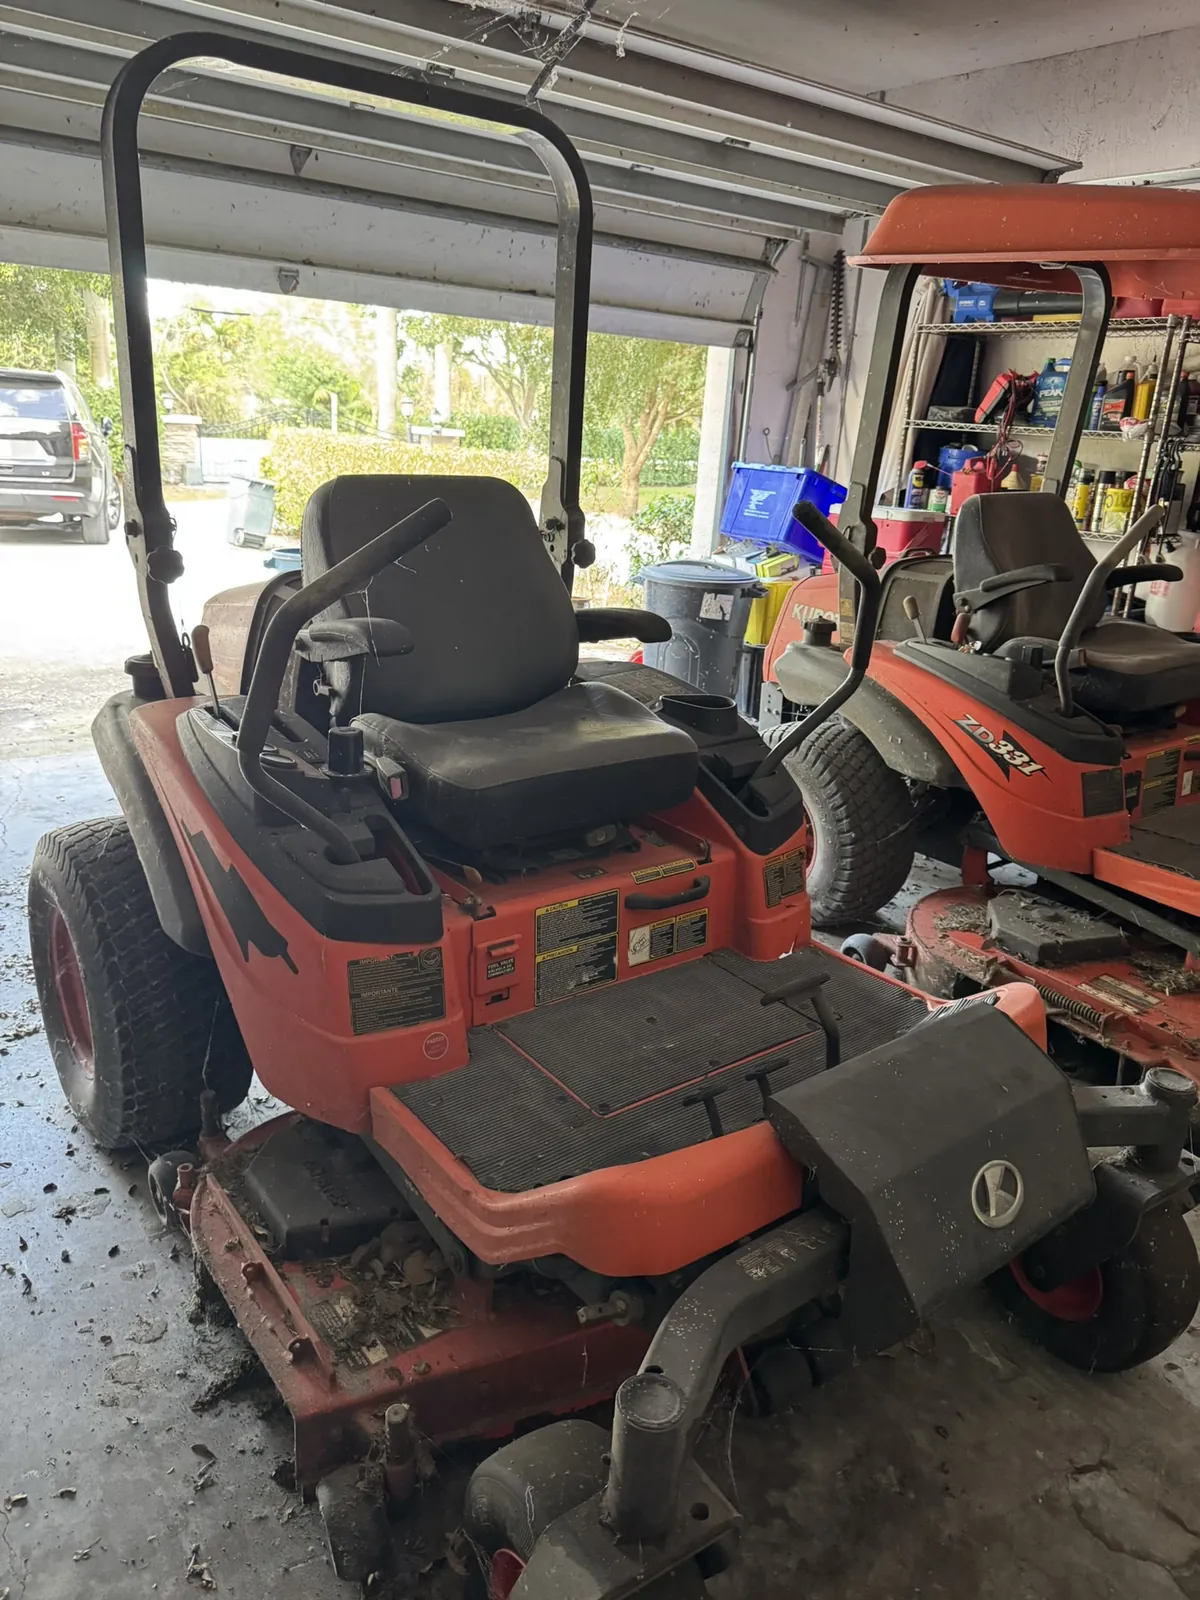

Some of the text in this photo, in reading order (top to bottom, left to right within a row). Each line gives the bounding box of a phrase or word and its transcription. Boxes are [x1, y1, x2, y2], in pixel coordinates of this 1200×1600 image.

[1039, 388, 1063, 398] PEAK
[955, 713, 1044, 776] ZD331
[360, 987, 398, 998] IMPORTANTE
